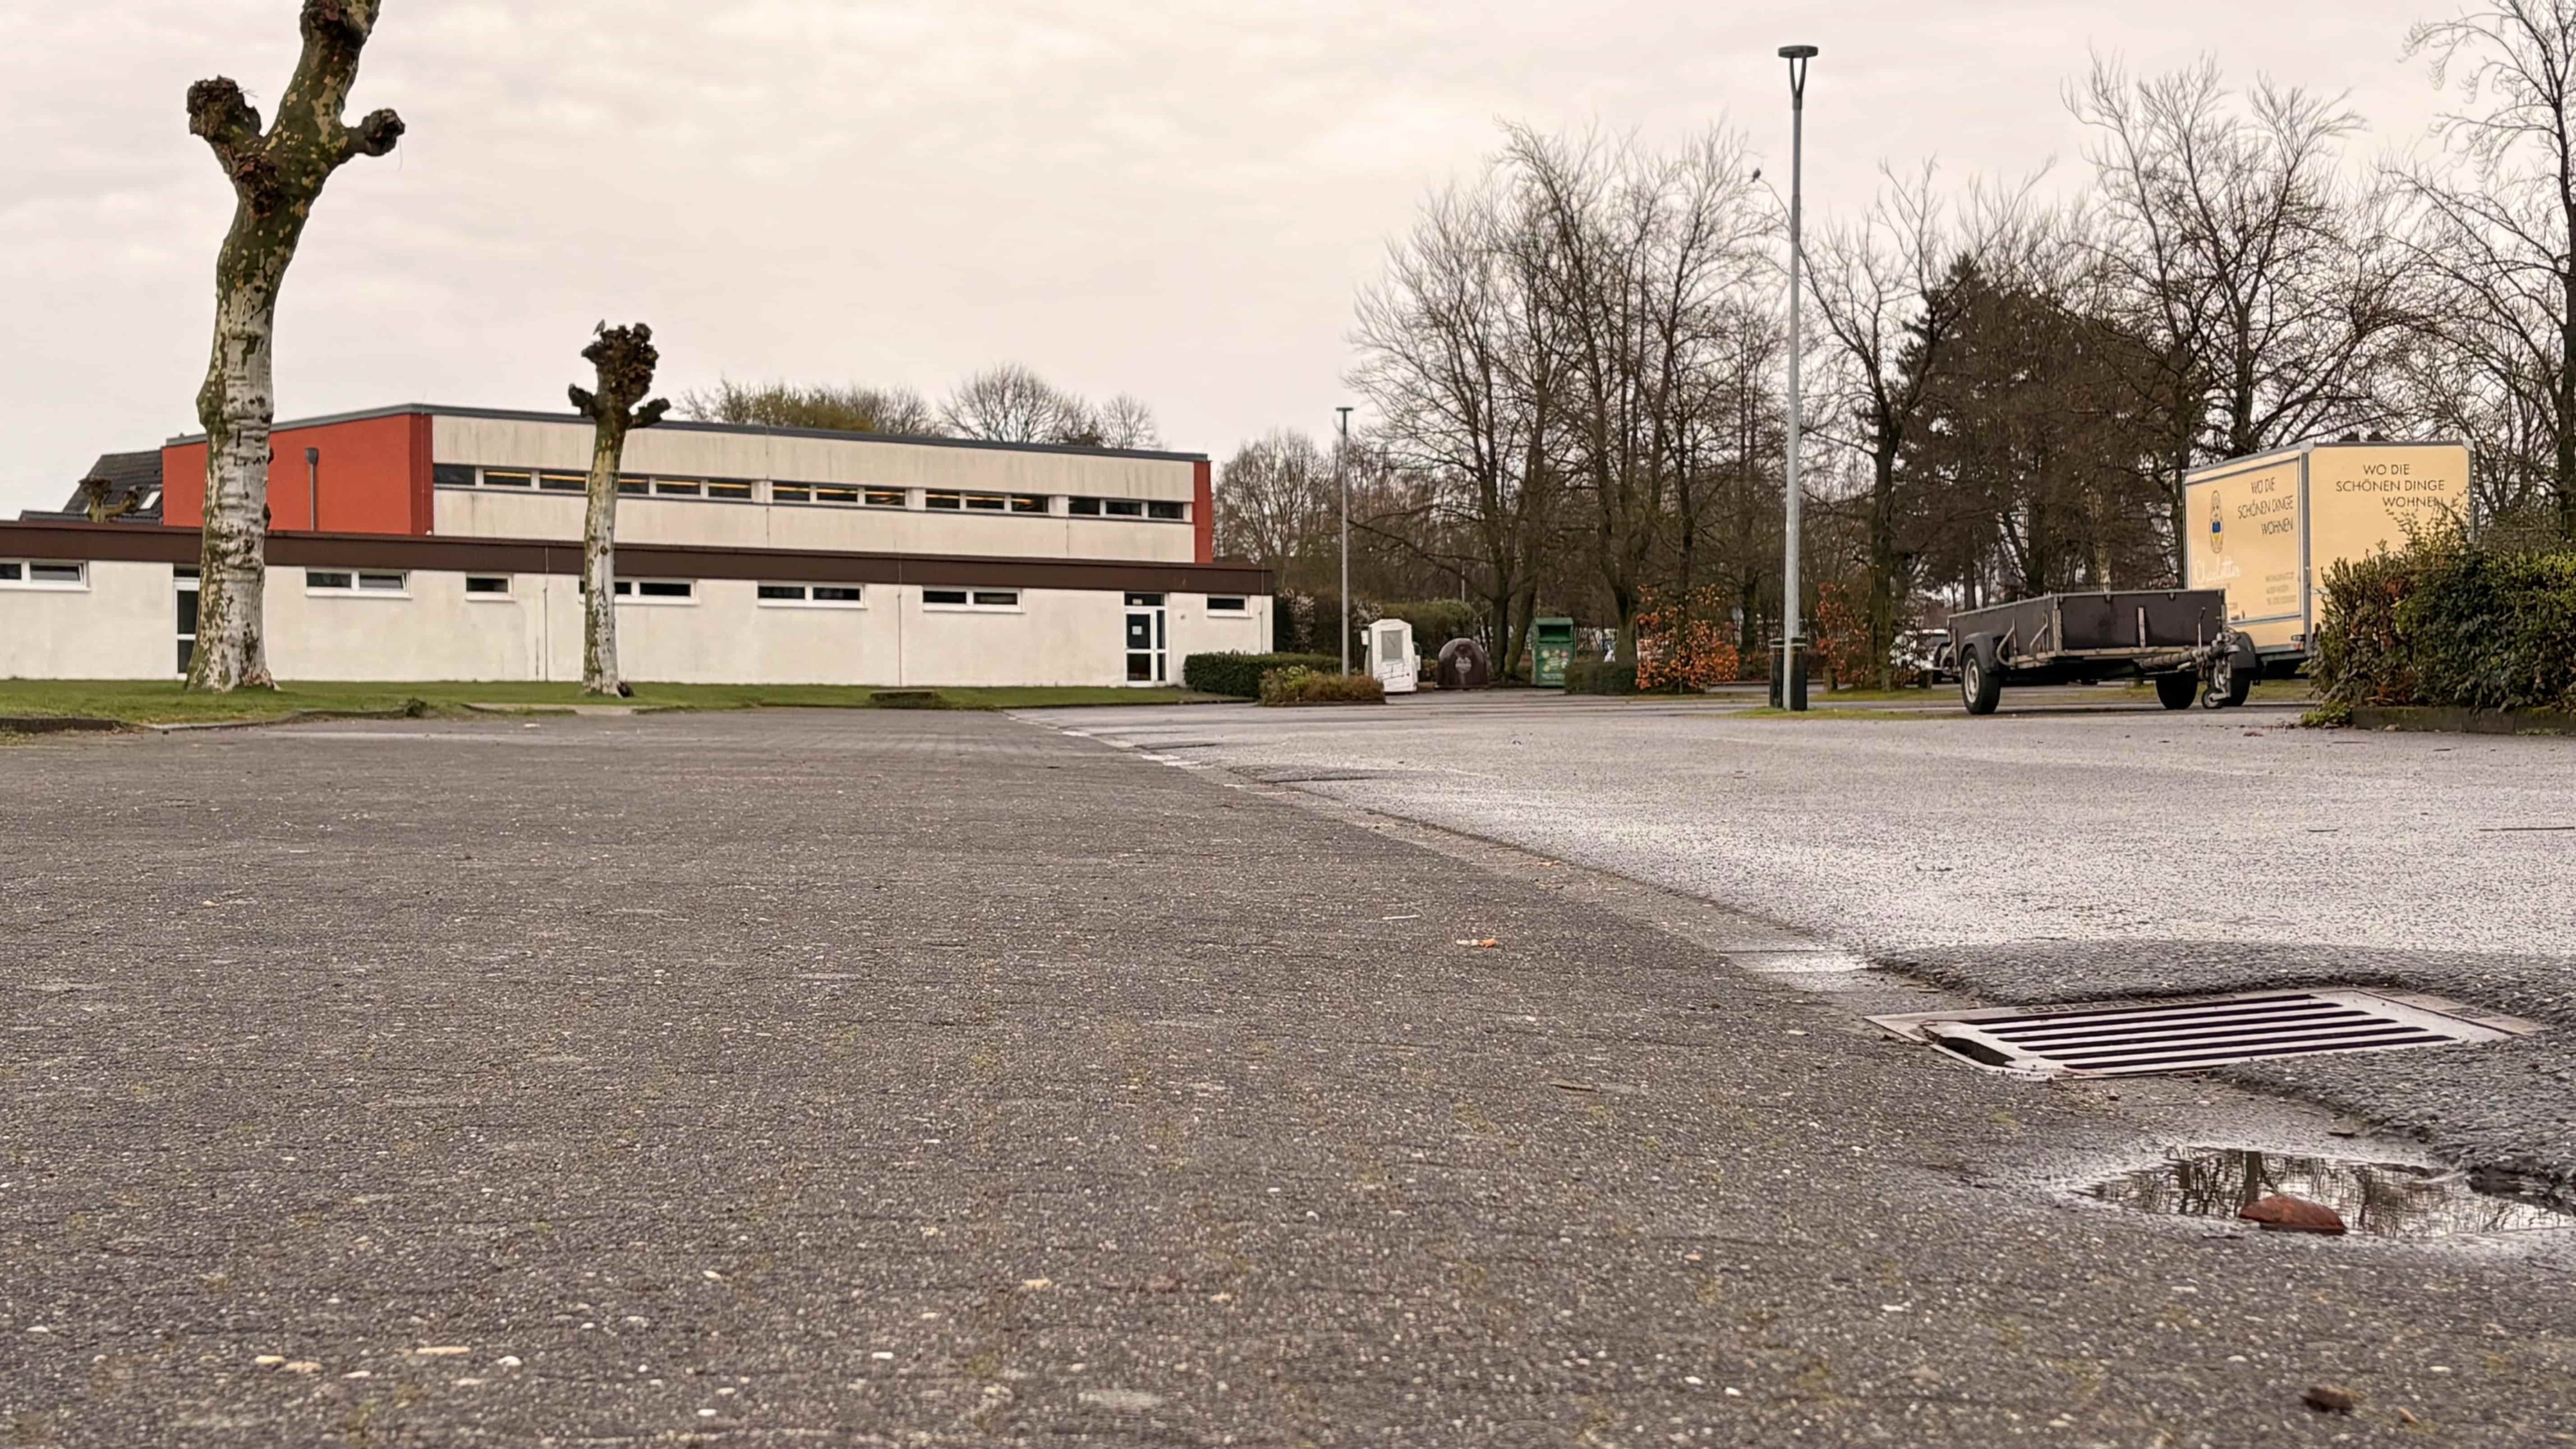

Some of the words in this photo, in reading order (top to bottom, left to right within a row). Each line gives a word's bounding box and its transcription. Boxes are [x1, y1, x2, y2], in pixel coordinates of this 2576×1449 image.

[2363, 464, 2387, 475] WO
[2391, 464, 2410, 475] DIE
[2336, 478, 2400, 492] SCHÖNEN
[2405, 480, 2445, 491] DINGE
[2382, 496, 2443, 507] WOHNEN
